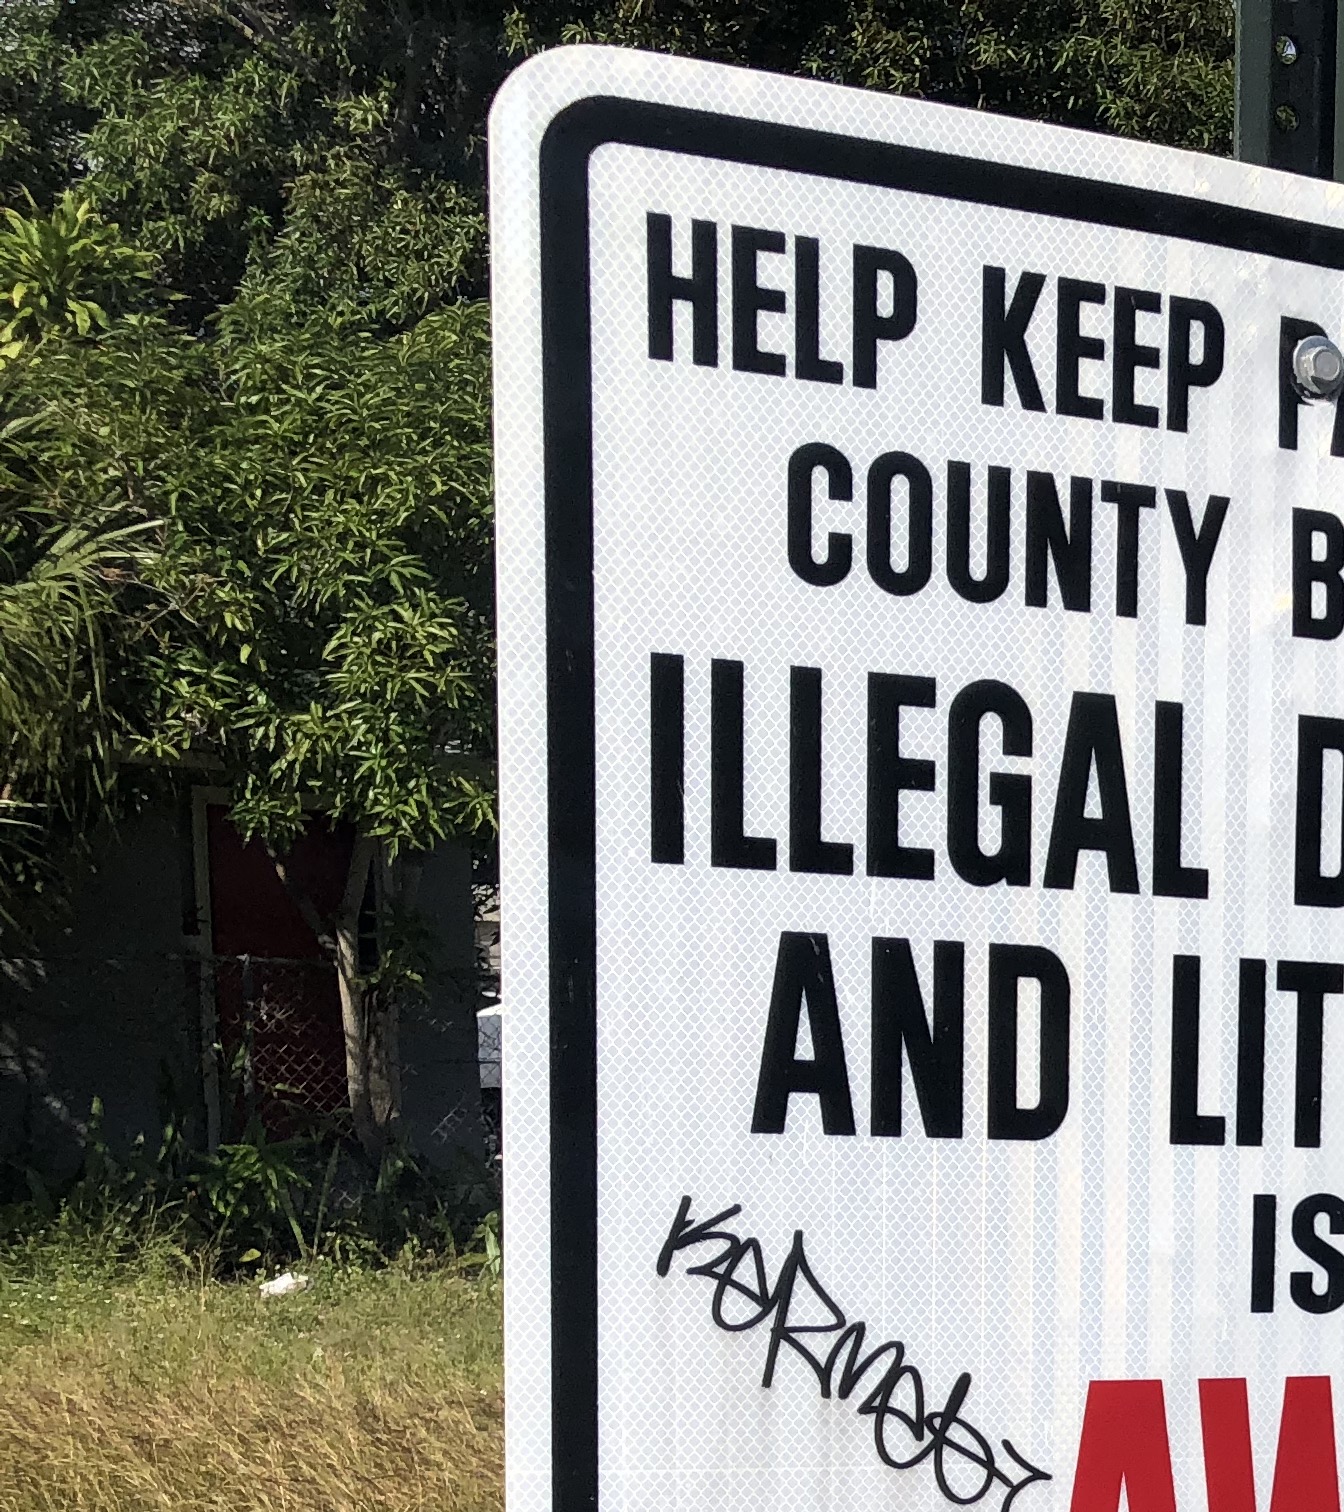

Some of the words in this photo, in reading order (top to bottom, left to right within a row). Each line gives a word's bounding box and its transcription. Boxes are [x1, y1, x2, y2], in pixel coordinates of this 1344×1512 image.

[647, 212, 917, 389] HELP
[982, 265, 1224, 433] KEEP
[788, 442, 1230, 626] COUNTY
[651, 652, 1208, 899] ILLEGAL
[751, 931, 1070, 1141] AND
